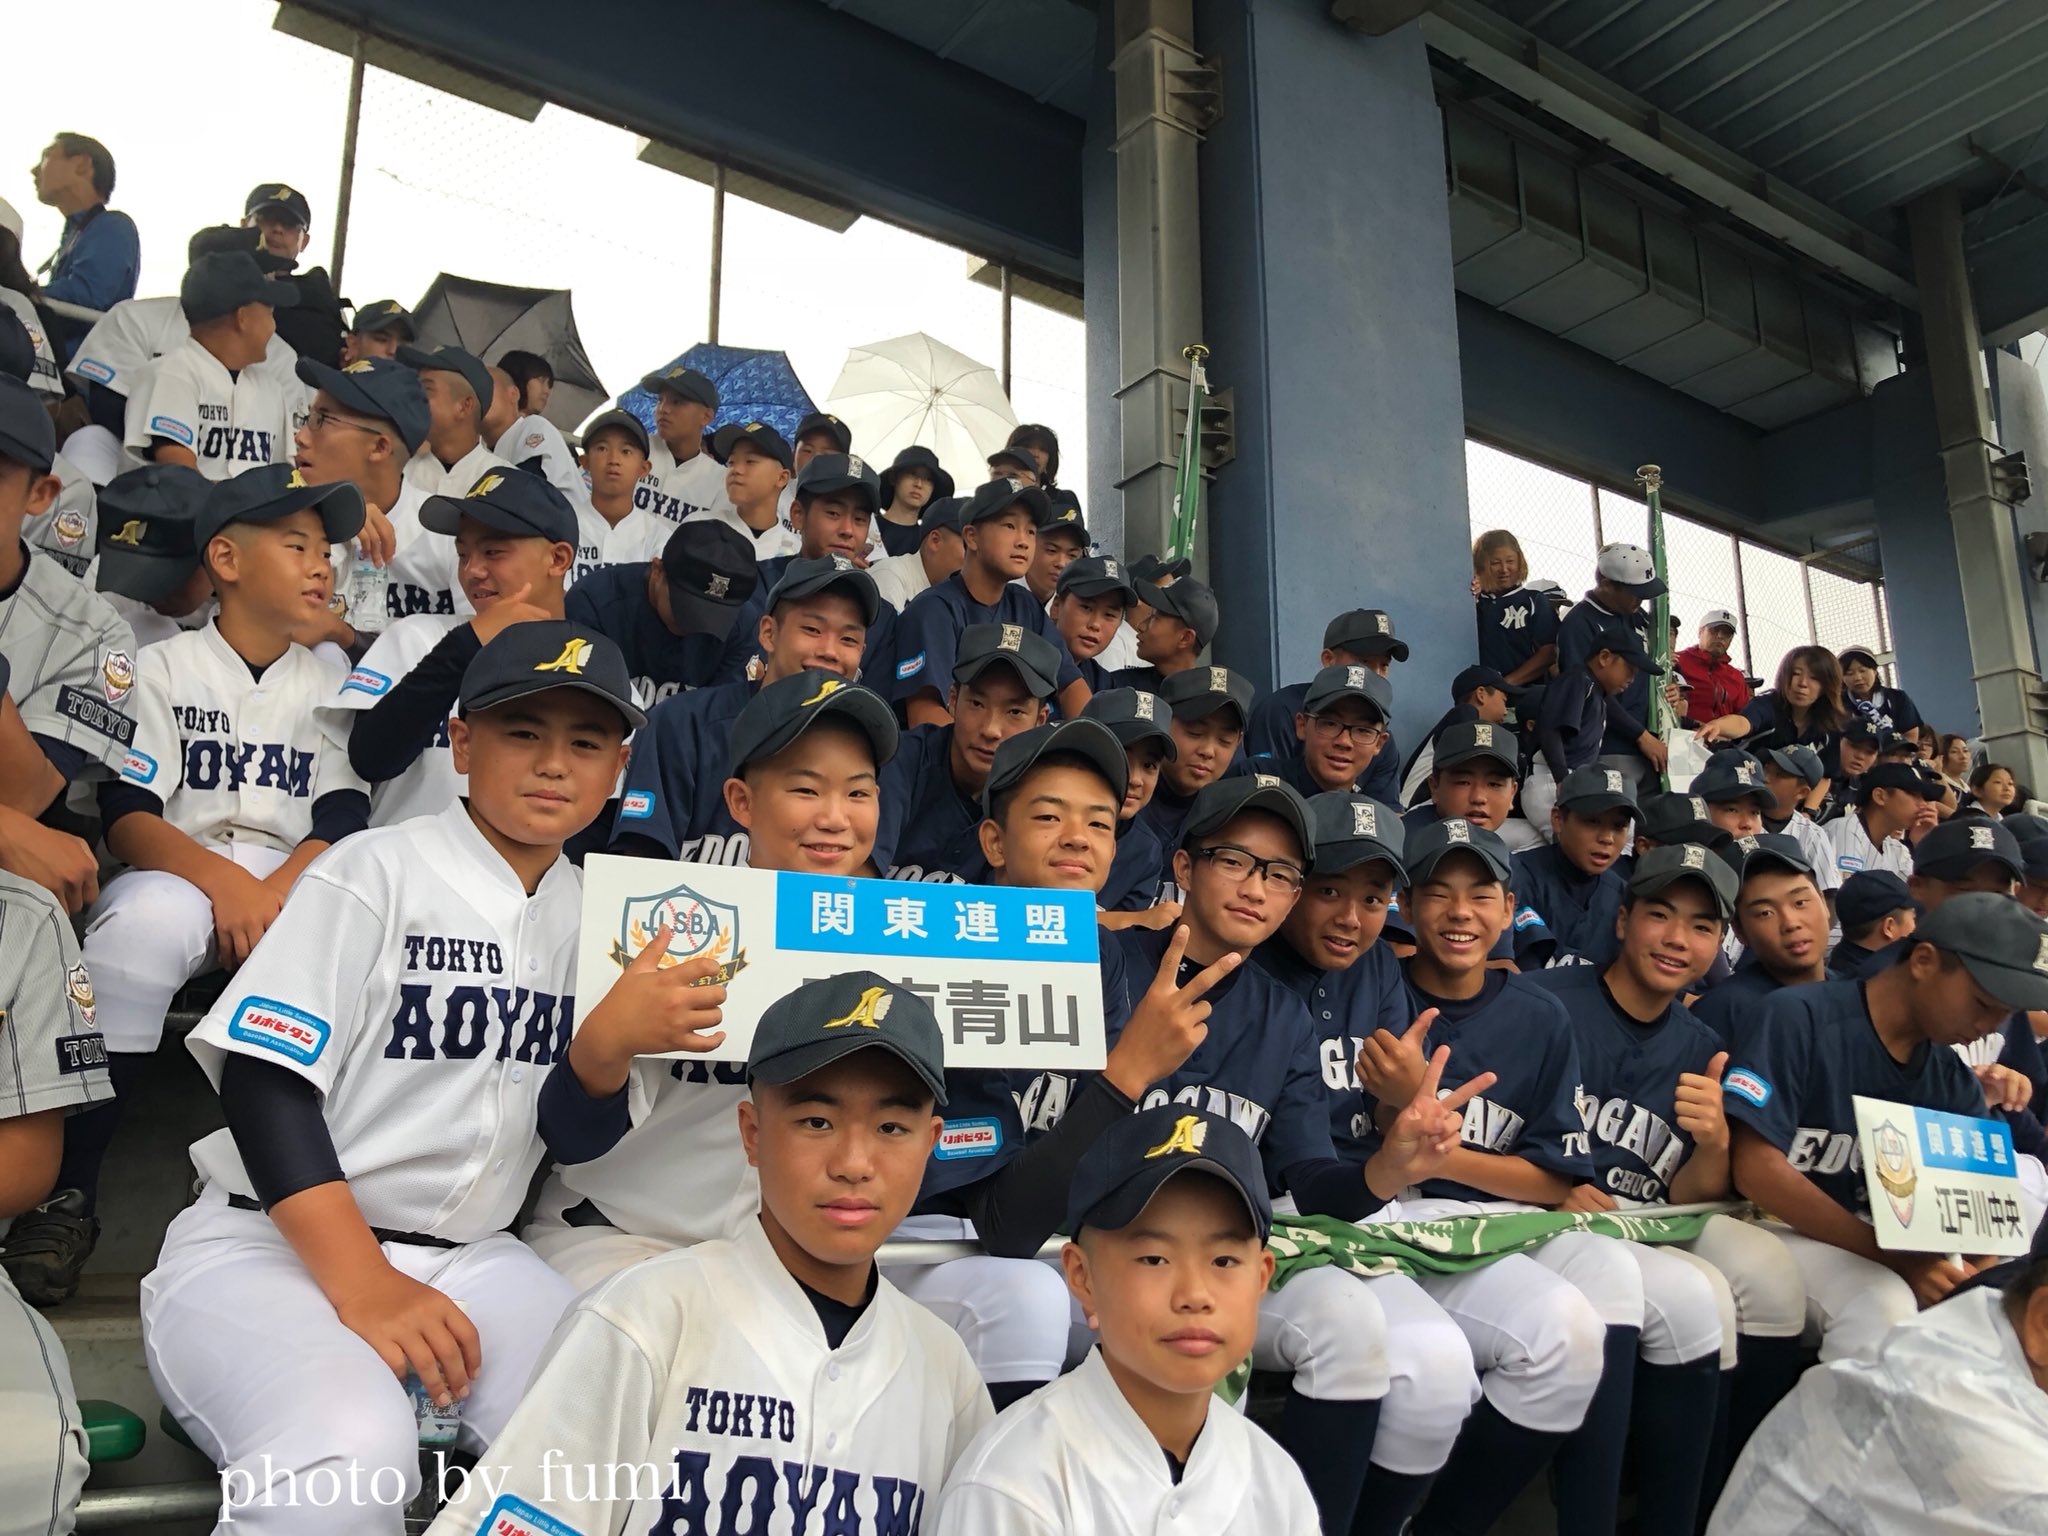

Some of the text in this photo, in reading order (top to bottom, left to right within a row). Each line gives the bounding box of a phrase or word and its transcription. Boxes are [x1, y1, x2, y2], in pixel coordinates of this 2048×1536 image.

[66, 690, 131, 741] TOKYO
[178, 739, 315, 798] OYAM
[811, 891, 1069, 945] 関東連盟
[404, 935, 504, 975] TOKYO
[246, 1012, 315, 1046] リポビタン
[943, 1131, 992, 1145] リポビタン
[1606, 1165, 1660, 1201] CHUO
[1934, 1185, 2024, 1239] 江戸川中央
[685, 1386, 795, 1443] TOKYO
[648, 1449, 926, 1536] AOYAM
